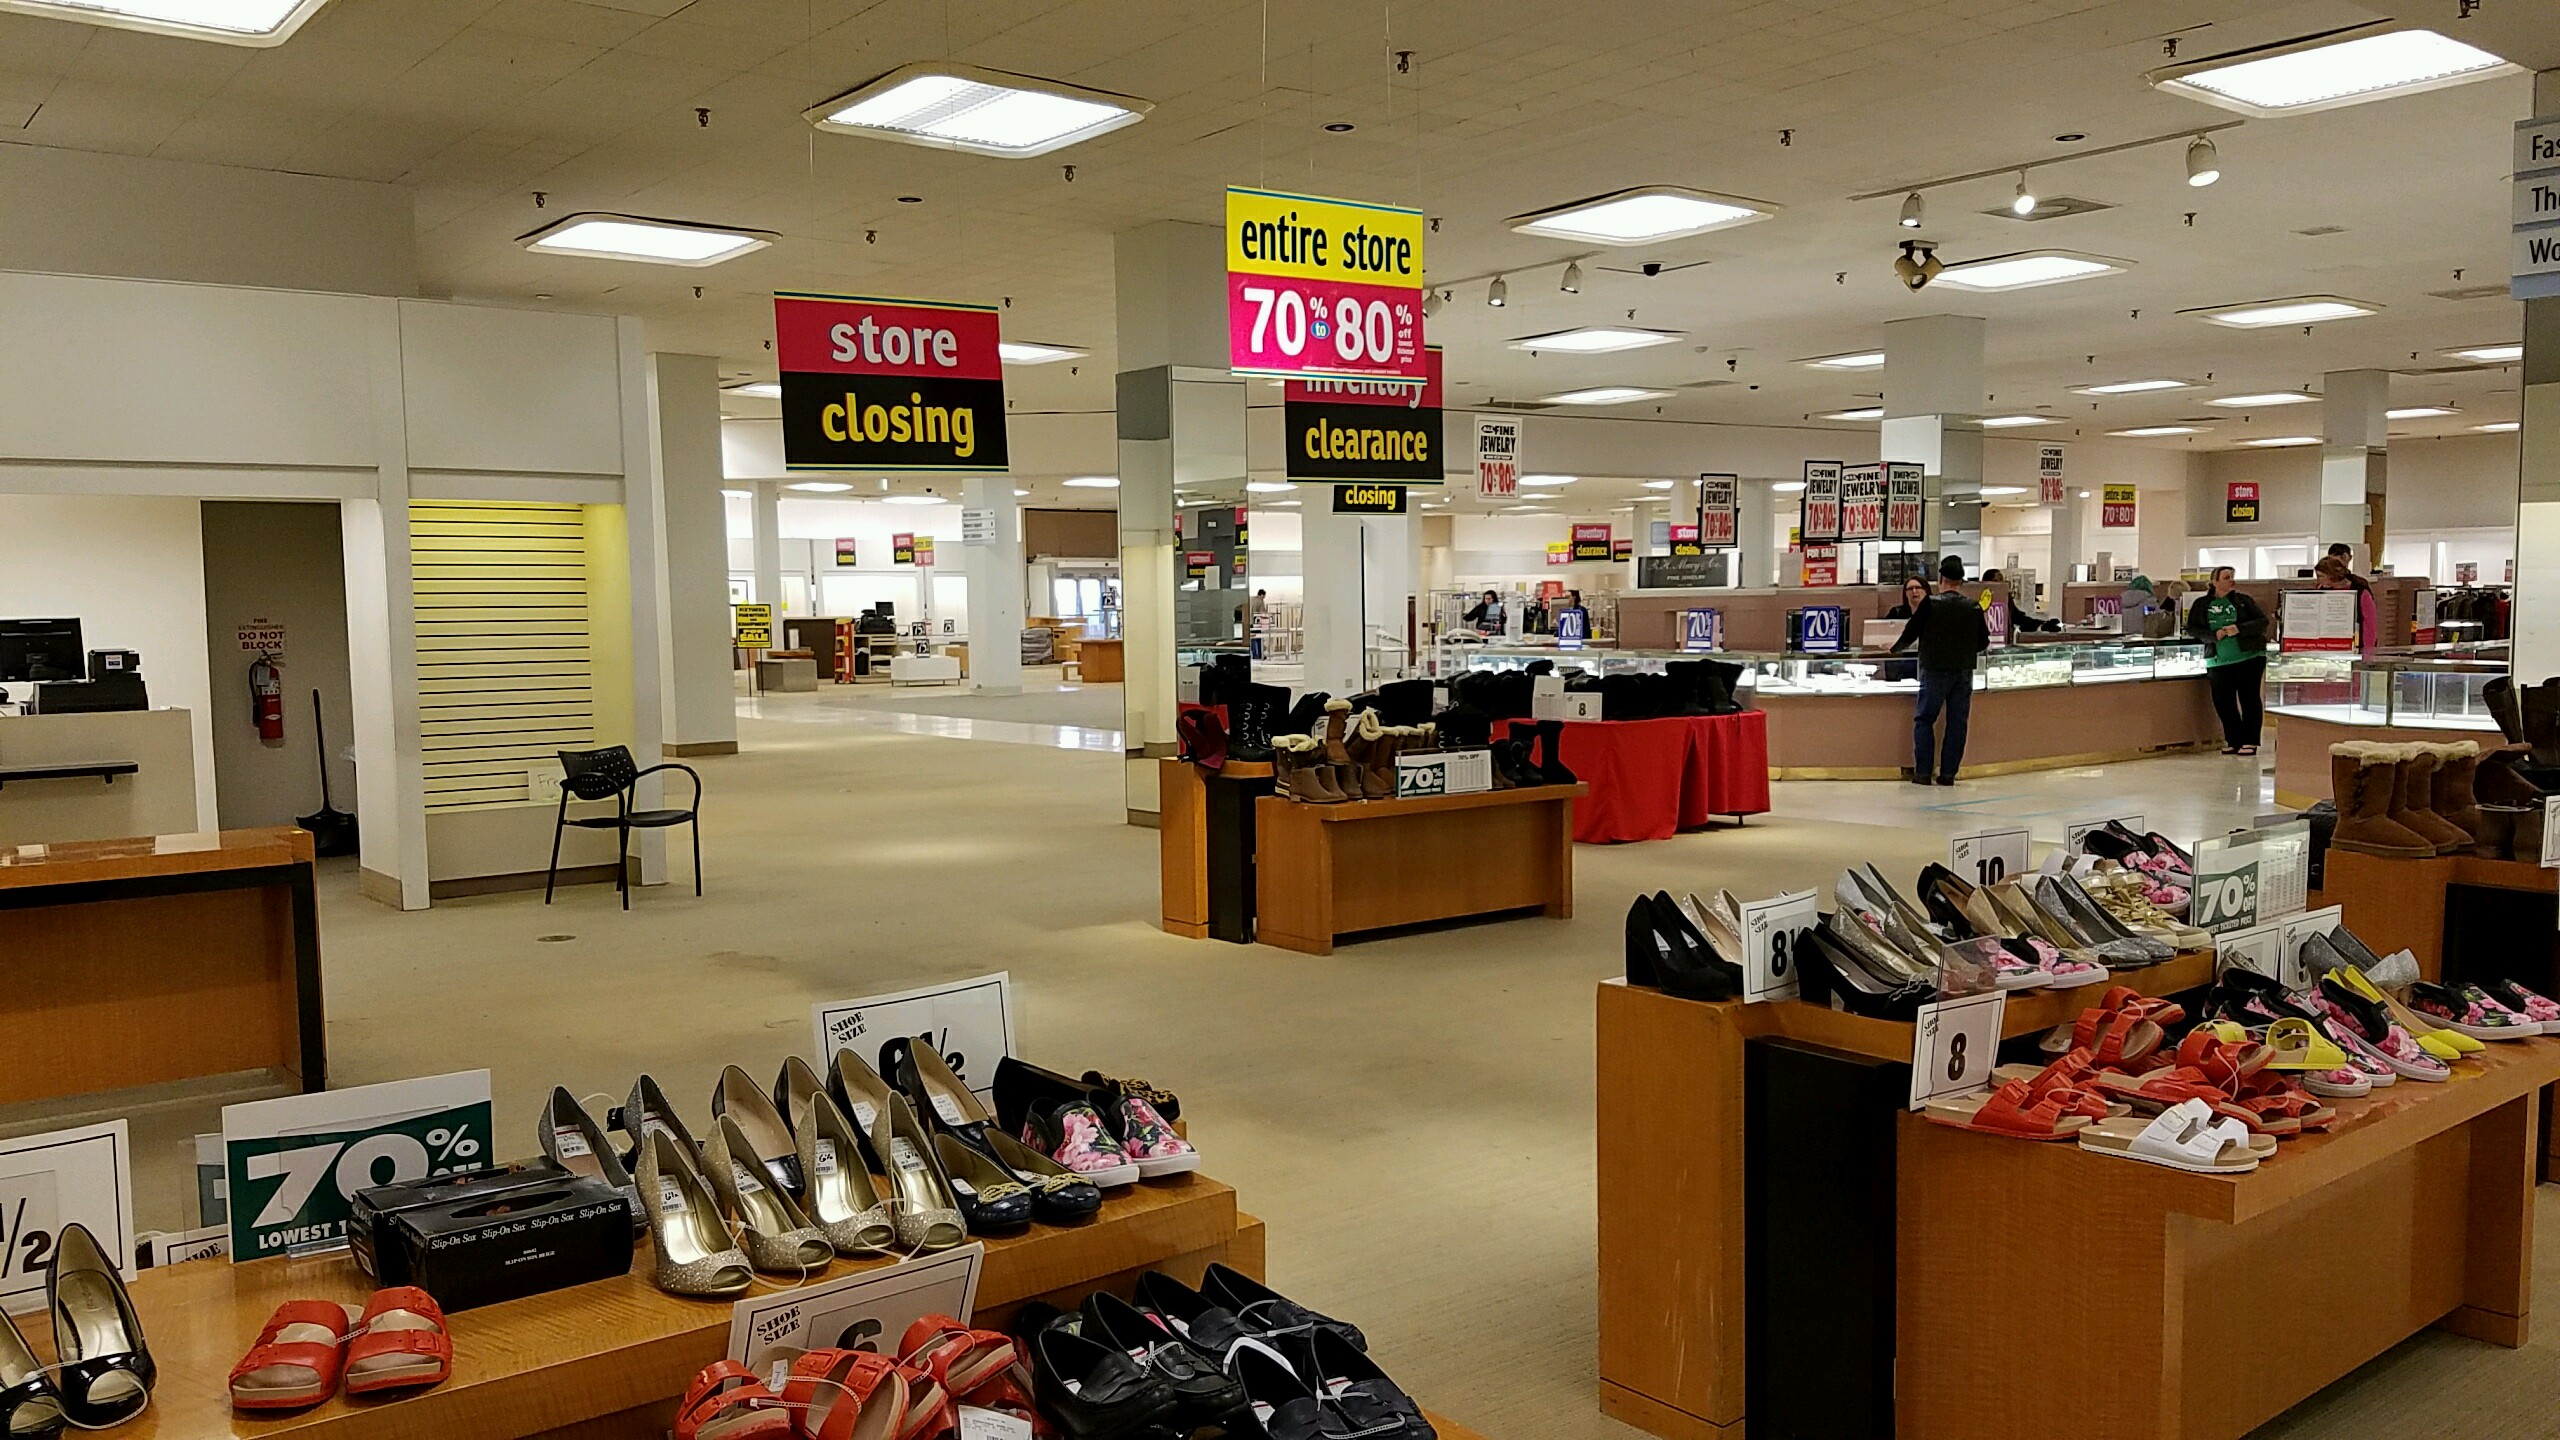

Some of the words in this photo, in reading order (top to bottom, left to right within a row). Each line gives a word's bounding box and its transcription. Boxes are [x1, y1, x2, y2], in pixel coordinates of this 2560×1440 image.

[2531, 185, 2560, 213] Th
[1241, 211, 1327, 266] entire
[1342, 224, 1411, 275] store
[830, 315, 958, 367] store
[822, 392, 976, 458] closing
[1494, 425, 1515, 436] FINE
[1305, 417, 1428, 462] clearance
[1480, 435, 1516, 453] JEWELRY
[1808, 480, 1837, 494] JEWELRY
[1858, 472, 1880, 481] FINE
[1345, 485, 1396, 511] closing
[2235, 485, 2253, 498] store
[238, 631, 256, 640] DO
[260, 631, 284, 640] NOT
[242, 641, 282, 650] BLOCK
[1578, 703, 1587, 716] 8
[1976, 856, 2004, 886] 10
[2243, 896, 2255, 912] OFF
[829, 1011, 865, 1035] SHOE
[837, 1022, 867, 1045] SIZE
[1947, 1032, 1967, 1081] 8
[258, 1222, 332, 1250] LOWEST
[431, 1235, 461, 1250] Slip-On
[461, 1233, 477, 1243] Sox
[481, 1227, 511, 1240] Slip-On
[512, 1222, 526, 1233] Sox
[530, 1215, 560, 1230] Slip-On
[560, 1212, 575, 1223] Sox
[579, 1205, 607, 1219] Slip-On
[608, 1202, 622, 1213] Sox
[756, 1305, 801, 1337] SHOE
[763, 1318, 801, 1346] SIZE
